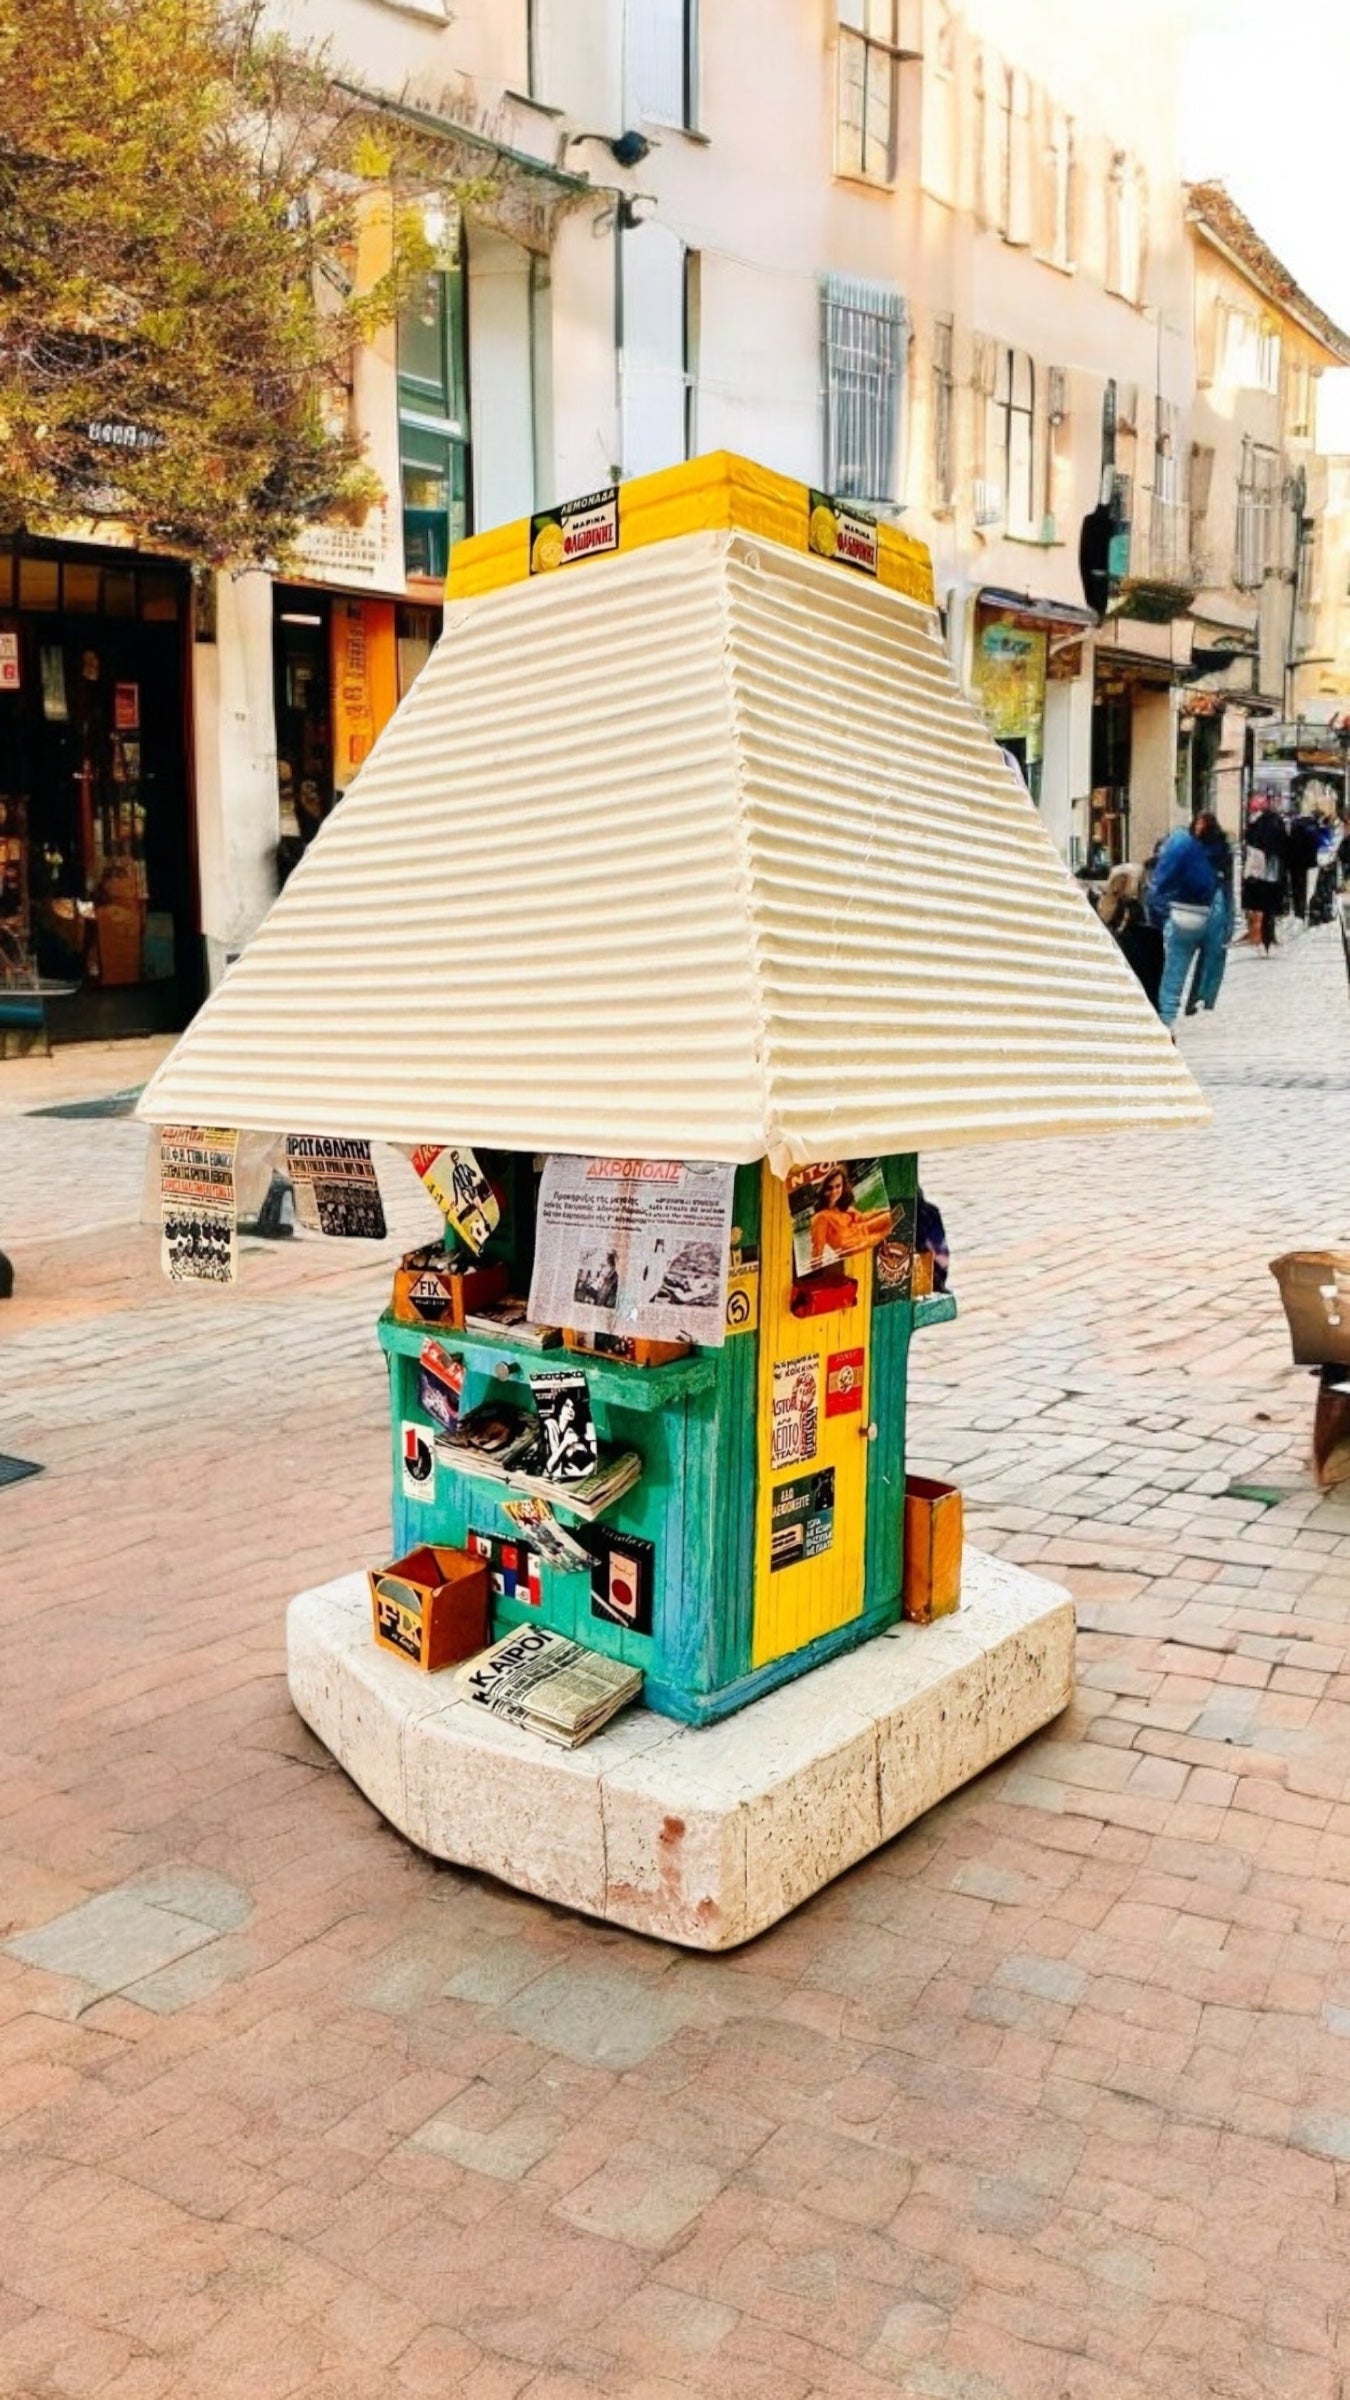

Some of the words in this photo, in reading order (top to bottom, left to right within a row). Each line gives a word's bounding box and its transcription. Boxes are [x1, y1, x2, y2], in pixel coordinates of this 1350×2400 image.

[561, 489, 615, 515] ΛΕΜΟΝΑΔΑ
[587, 1160, 682, 1180] ΑΚΡΟΠΟΛΙΣ
[420, 1280, 440, 1296] FIX
